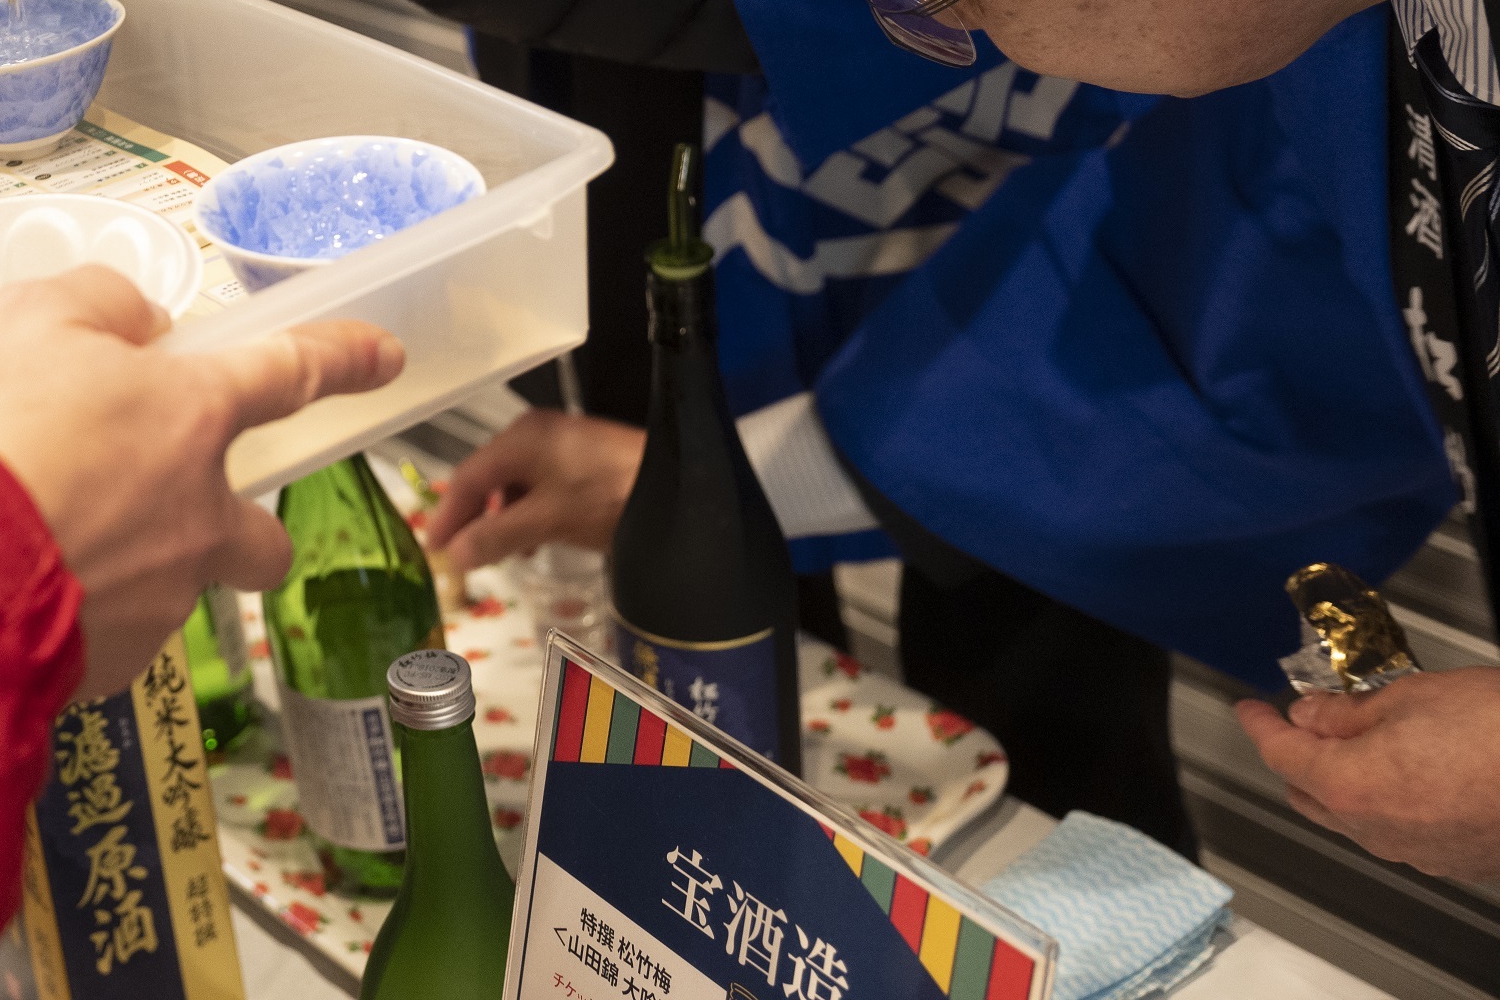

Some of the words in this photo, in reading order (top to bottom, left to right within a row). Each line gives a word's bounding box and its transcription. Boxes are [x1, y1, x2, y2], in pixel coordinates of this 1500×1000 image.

[54, 695, 159, 976] 濾過原酒
[580, 907, 615, 952] 特撰
[617, 936, 672, 995] 松竹梅
[661, 846, 849, 1000] 宝酒造
